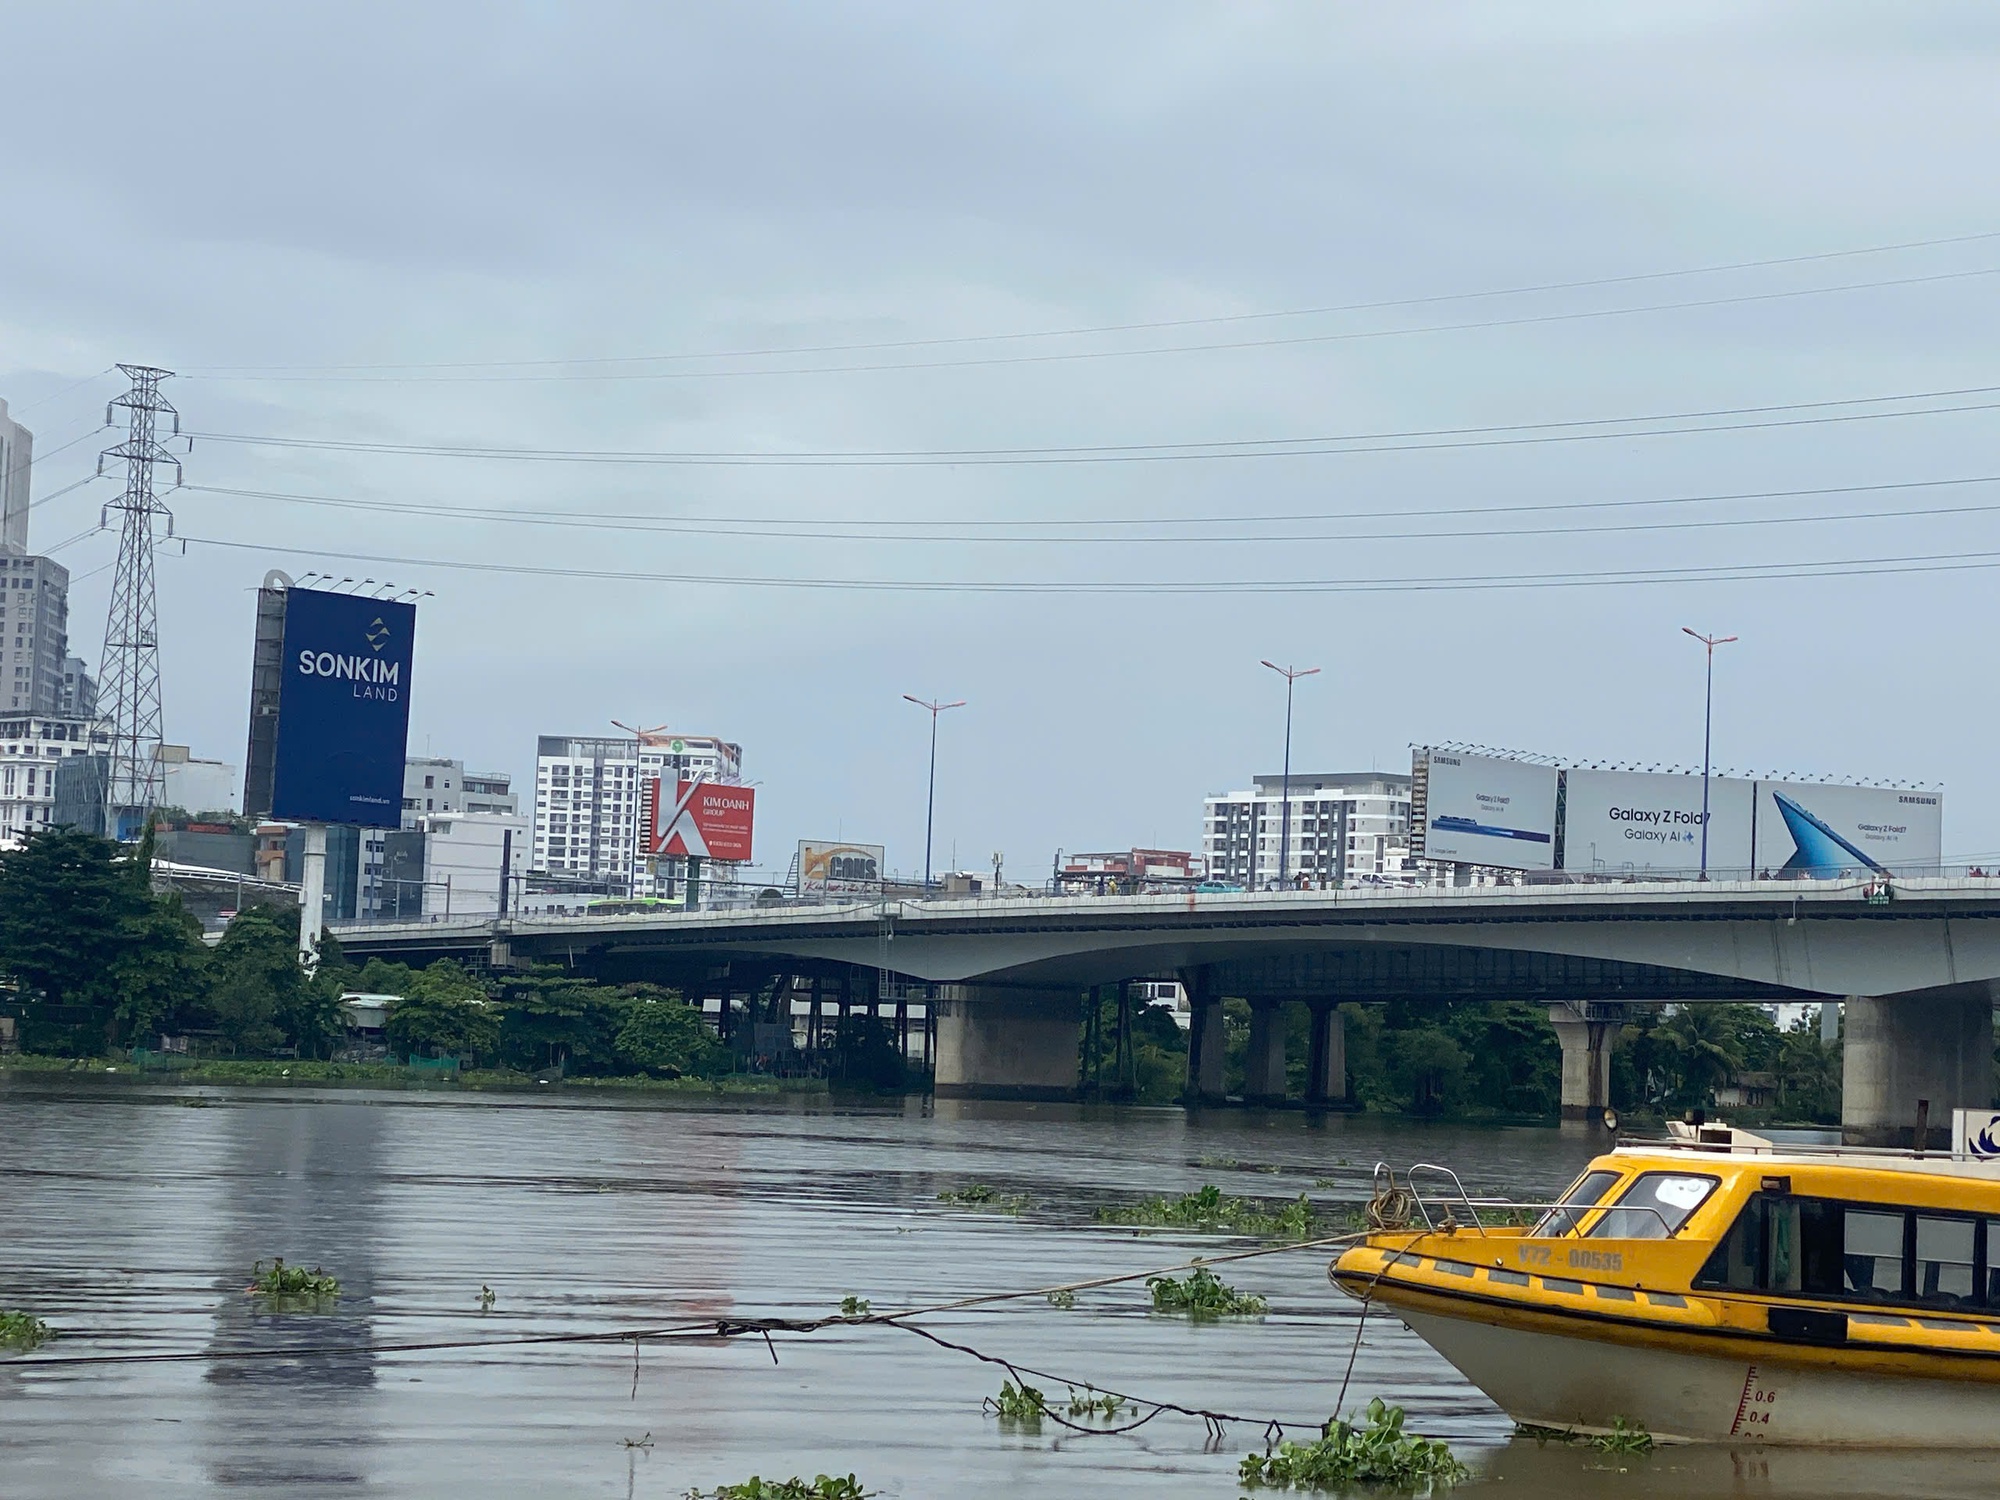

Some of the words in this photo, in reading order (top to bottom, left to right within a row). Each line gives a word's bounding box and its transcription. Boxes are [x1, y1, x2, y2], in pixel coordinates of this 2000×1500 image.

[299, 650, 399, 685] SONKIM
[353, 684, 398, 702] LAND
[1433, 756, 1461, 766] SAMSUNG
[703, 796, 720, 808] KIM
[722, 799, 749, 811] OANH
[1898, 795, 1937, 805] SAMSUNG
[703, 808, 725, 816] GROUP
[1609, 807, 1661, 826] Galaxy
[1663, 810, 1671, 823] Z
[1857, 823, 1883, 833] Galaxy
[1624, 828, 1667, 844] Galaxy
[1669, 831, 1681, 842] AI
[1569, 1248, 1623, 1272] 00535
[1755, 1390, 1776, 1403] 0.6
[1749, 1411, 1770, 1424] 0.4
